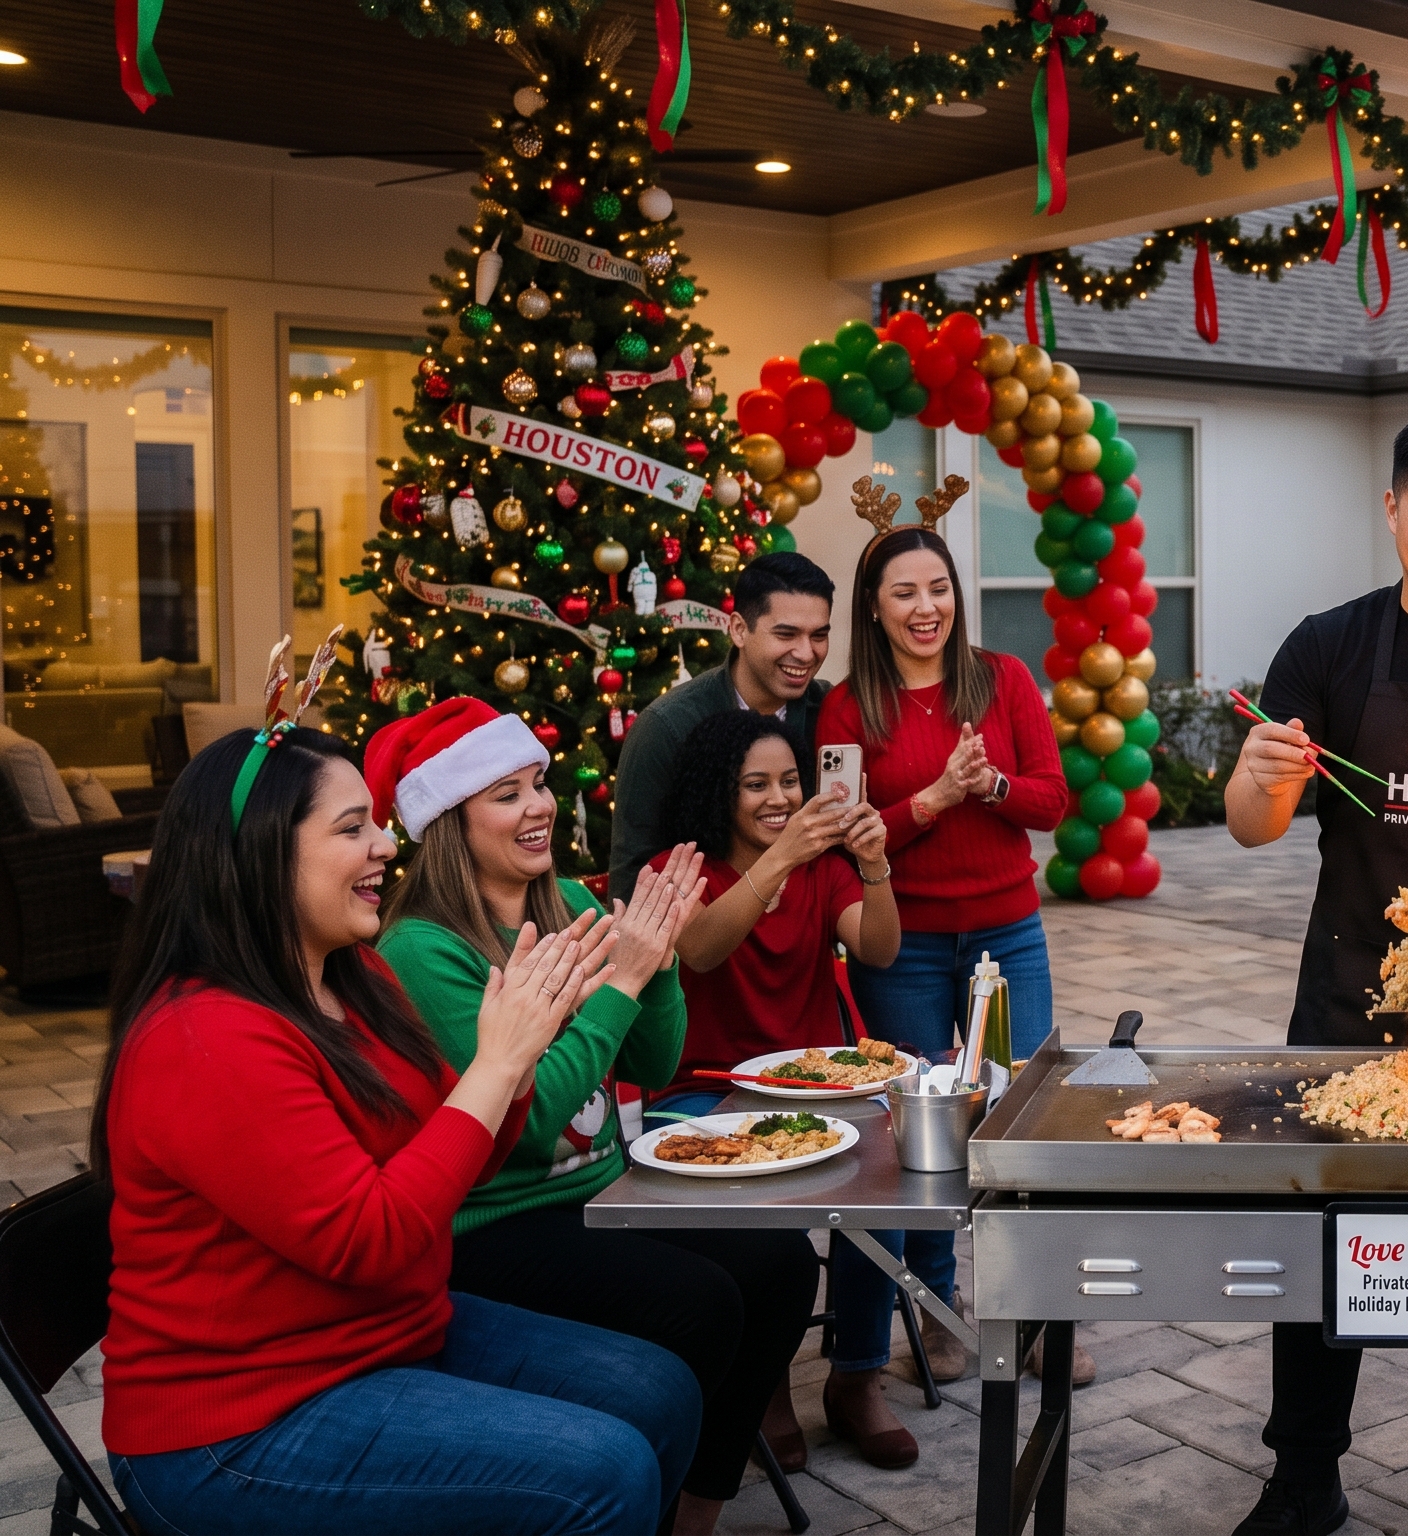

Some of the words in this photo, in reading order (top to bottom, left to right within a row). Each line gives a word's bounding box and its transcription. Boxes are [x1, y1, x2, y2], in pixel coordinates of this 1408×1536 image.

[503, 421, 661, 490] HOUSTON
[1347, 1235, 1405, 1269] Love
[1348, 1295, 1401, 1316] Holiday
